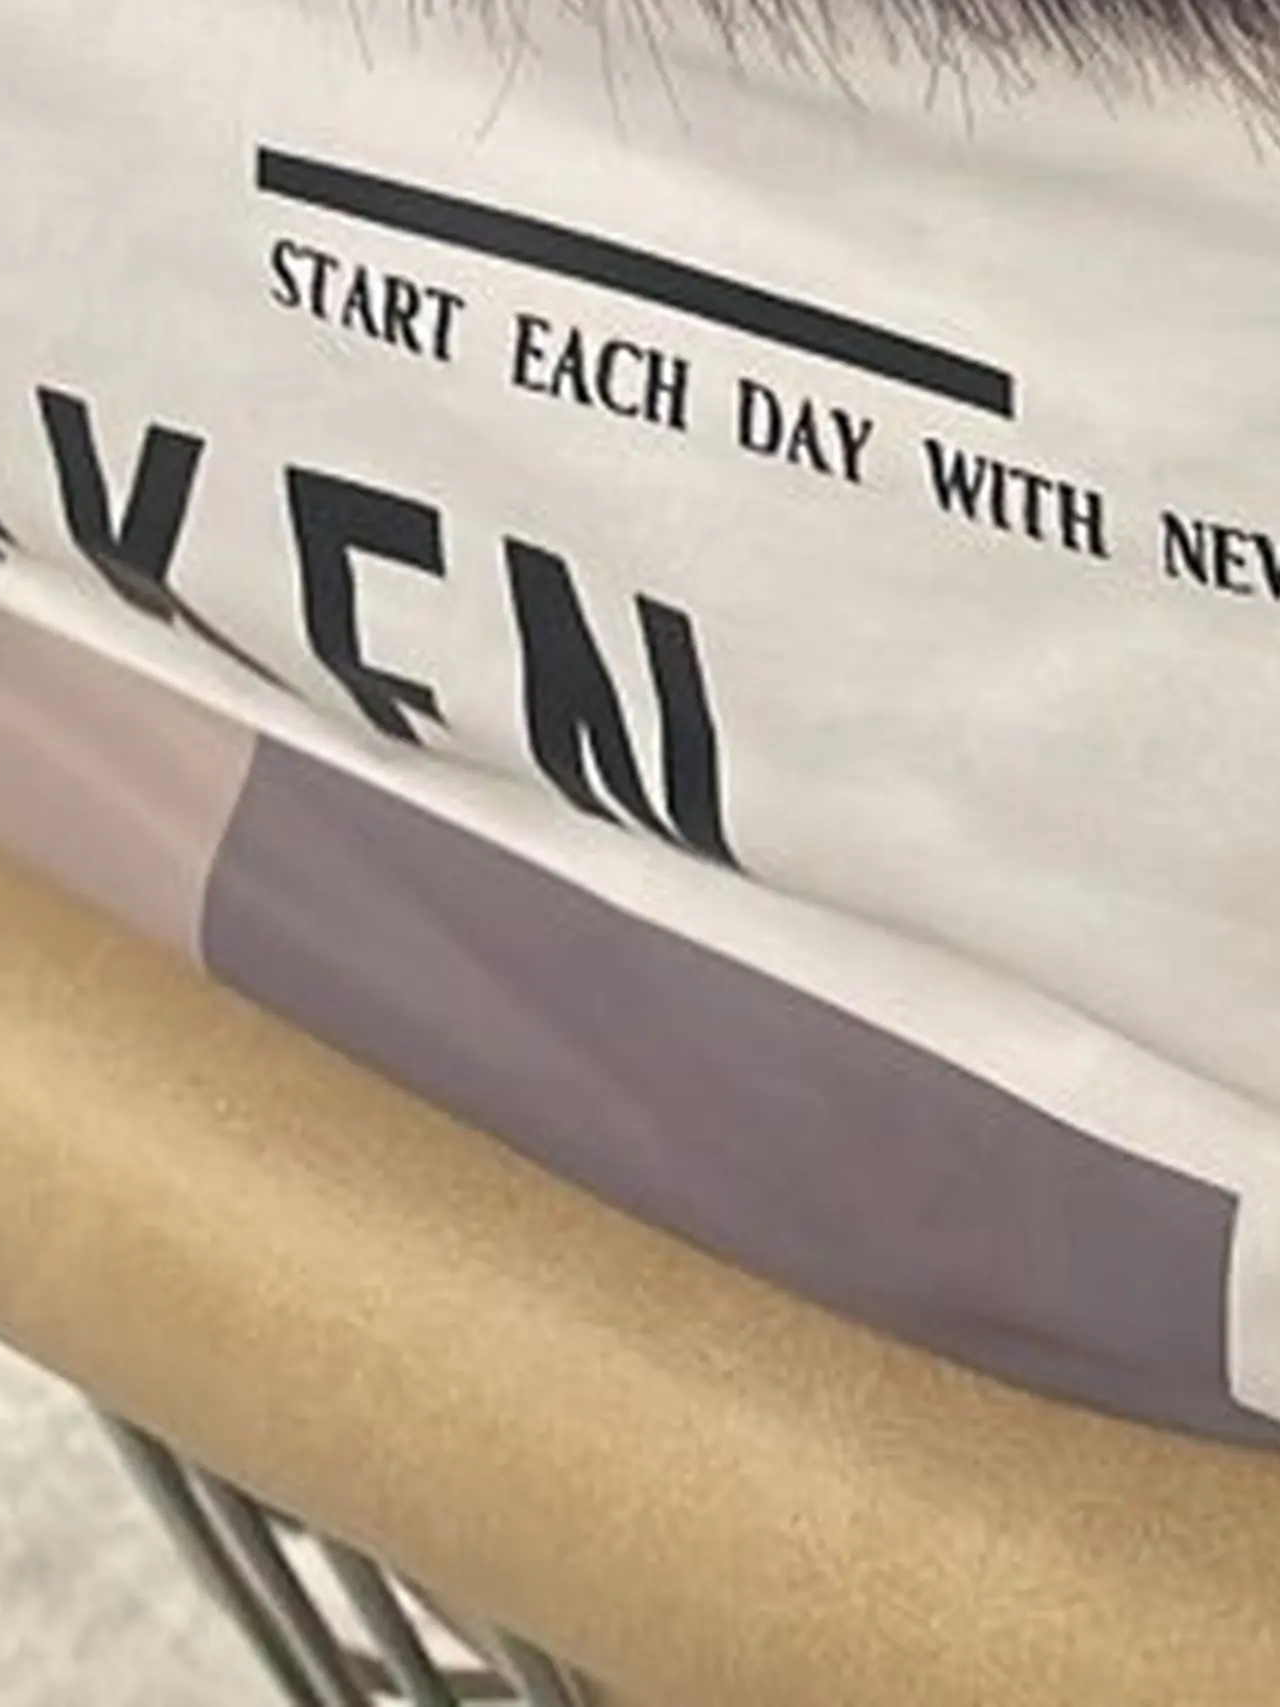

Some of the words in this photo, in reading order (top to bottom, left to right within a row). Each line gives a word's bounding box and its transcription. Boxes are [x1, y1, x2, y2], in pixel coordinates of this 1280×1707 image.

[271, 239, 466, 363] START
[512, 314, 688, 432] EACH
[738, 378, 873, 484] DAY
[923, 438, 1108, 559] WITH
